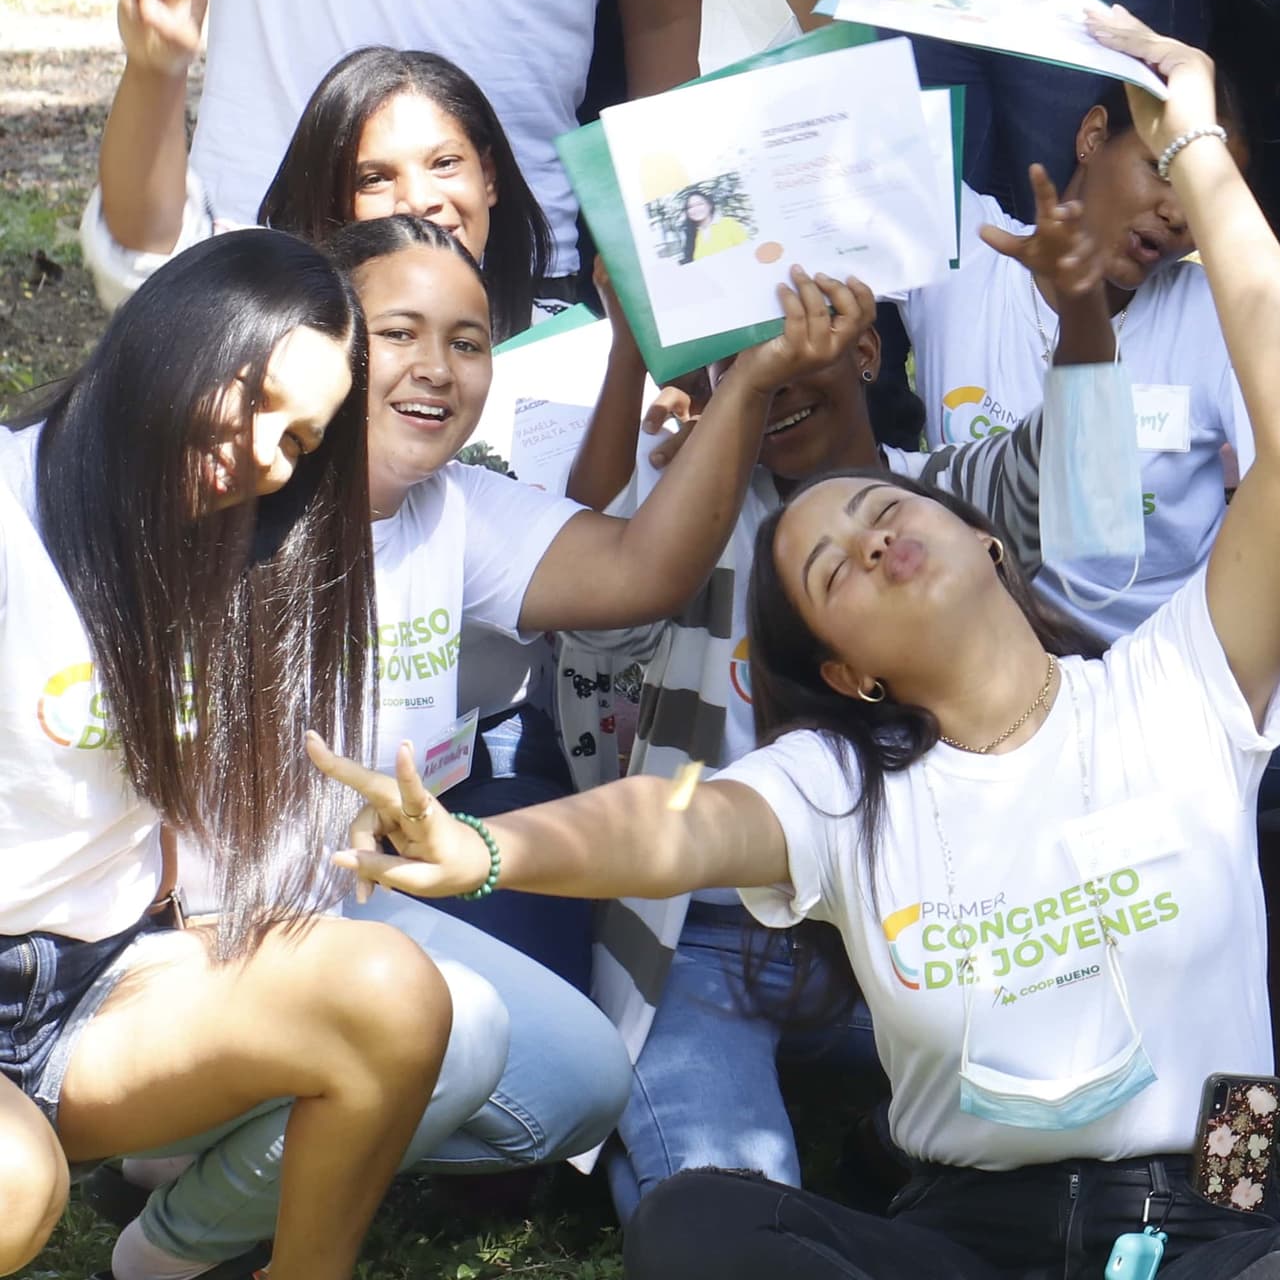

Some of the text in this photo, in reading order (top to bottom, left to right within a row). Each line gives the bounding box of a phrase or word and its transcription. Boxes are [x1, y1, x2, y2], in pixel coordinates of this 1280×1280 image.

[922, 869, 1140, 952] CONGRESO
[991, 891, 1180, 977] JÓVENES
[1019, 964, 1101, 997] COOPBUENO
